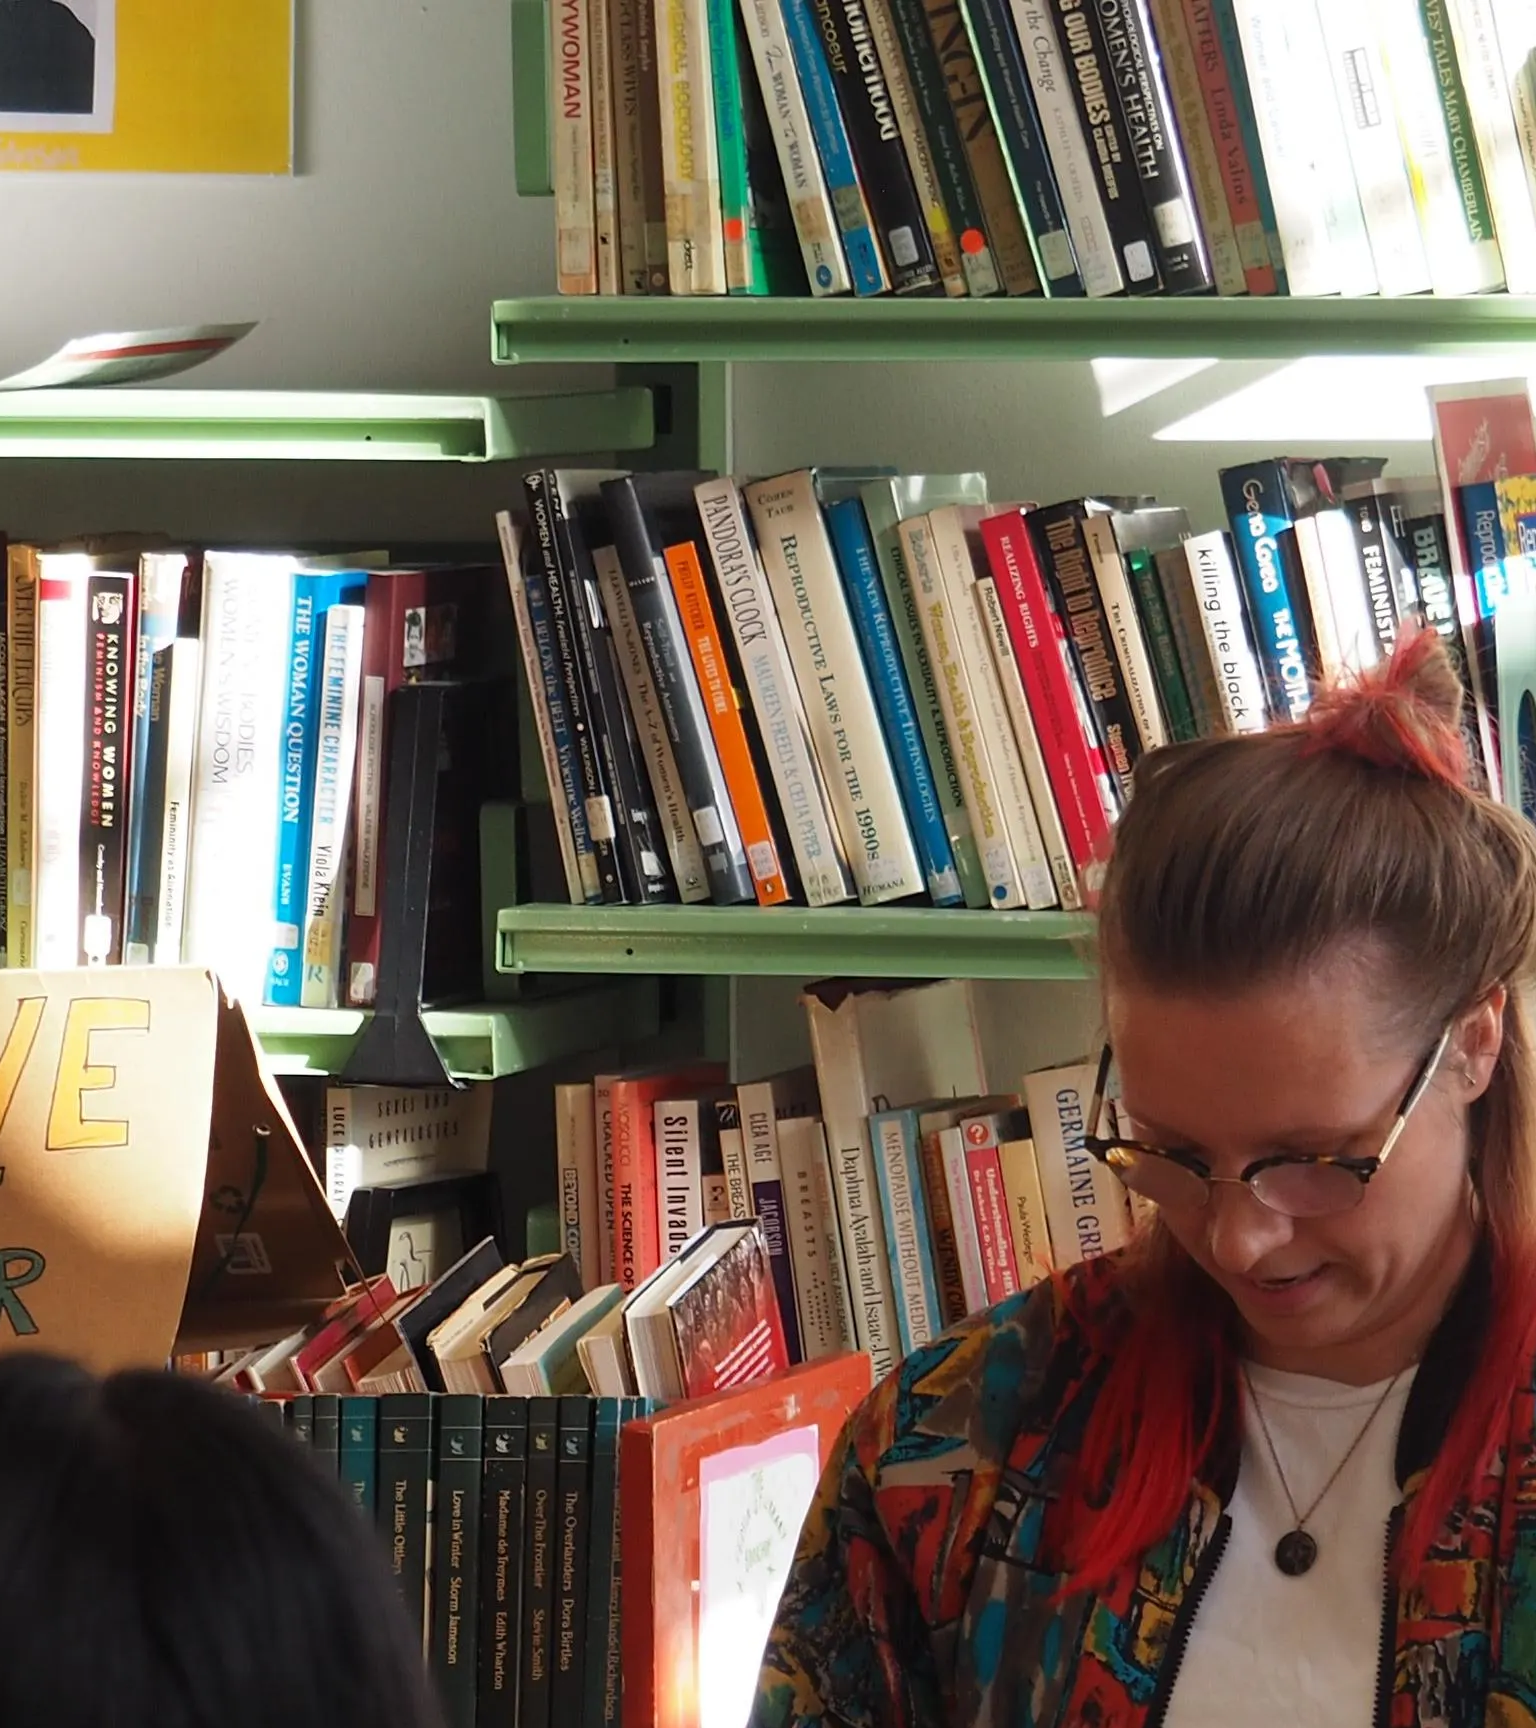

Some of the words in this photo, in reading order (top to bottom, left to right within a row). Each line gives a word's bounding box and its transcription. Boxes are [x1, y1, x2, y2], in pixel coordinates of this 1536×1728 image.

[1024, 7, 1045, 32] the
[1063, 12, 1092, 55] OUR
[1027, 34, 1061, 94] Change
[1431, 37, 1453, 87] TALES
[1074, 54, 1110, 125] BODIES
[1209, 87, 1233, 141] Linda
[1442, 90, 1463, 133] MARY
[1122, 93, 1159, 180] HEALTH
[1451, 136, 1485, 242] CHAMBERLAIN
[532, 498, 551, 547] WOMEN
[1044, 516, 1080, 551] The
[701, 494, 751, 590] PANDORA'S
[726, 585, 770, 646] CLOCK
[999, 535, 1025, 600] REALIZING
[1017, 602, 1039, 648] RIGHTS
[1050, 547, 1092, 595] Right
[1192, 547, 1226, 613] killing
[1362, 544, 1394, 641] FEMINIST
[294, 595, 312, 634] THE
[1064, 592, 1094, 612] to
[329, 623, 347, 653] THE
[1069, 610, 1117, 702] Reproduce
[1212, 619, 1235, 653] the
[94, 632, 104, 701] FEMINISM
[104, 633, 118, 734] KNOWING
[288, 639, 309, 717] WOMAN
[324, 657, 344, 729] FEMININE
[1221, 659, 1250, 720] black
[92, 707, 103, 735] AND
[211, 690, 233, 784] WISDOM
[100, 745, 114, 827] WOMEN
[281, 722, 305, 823] QUESTION
[318, 734, 339, 824] CHARACTER
[832, 728, 852, 763] FOR
[843, 766, 864, 801] THE
[854, 806, 884, 862] 1990s
[314, 844, 330, 878] Viola
[312, 882, 328, 917] Klein
[333, 1106, 344, 1136] LUCE
[663, 1116, 689, 1176] Silent
[1052, 1087, 1098, 1209] GERMAINE
[726, 1151, 739, 1176] THE
[839, 1146, 867, 1210] Daphna
[565, 1170, 577, 1224] BEYOND
[621, 1183, 633, 1207] THE
[797, 1171, 816, 1258] BREASTS
[884, 1131, 909, 1215] MENOPAUSE
[897, 1218, 920, 1289] WITHOUT
[982, 1167, 1009, 1267] Understanding
[622, 1211, 633, 1264] SCIENCE
[847, 1210, 876, 1266] Ayalah
[622, 1267, 633, 1285] OF
[860, 1265, 879, 1296] and
[865, 1299, 886, 1344] Isaac
[452, 1489, 463, 1517] Love
[564, 1491, 577, 1513] The
[450, 1531, 462, 1568] Winter
[562, 1516, 576, 1591] Overlanders
[448, 1576, 462, 1611] Storm
[560, 1598, 573, 1627] Dora
[446, 1614, 460, 1664] Jameson
[560, 1630, 572, 1671] Birtles
